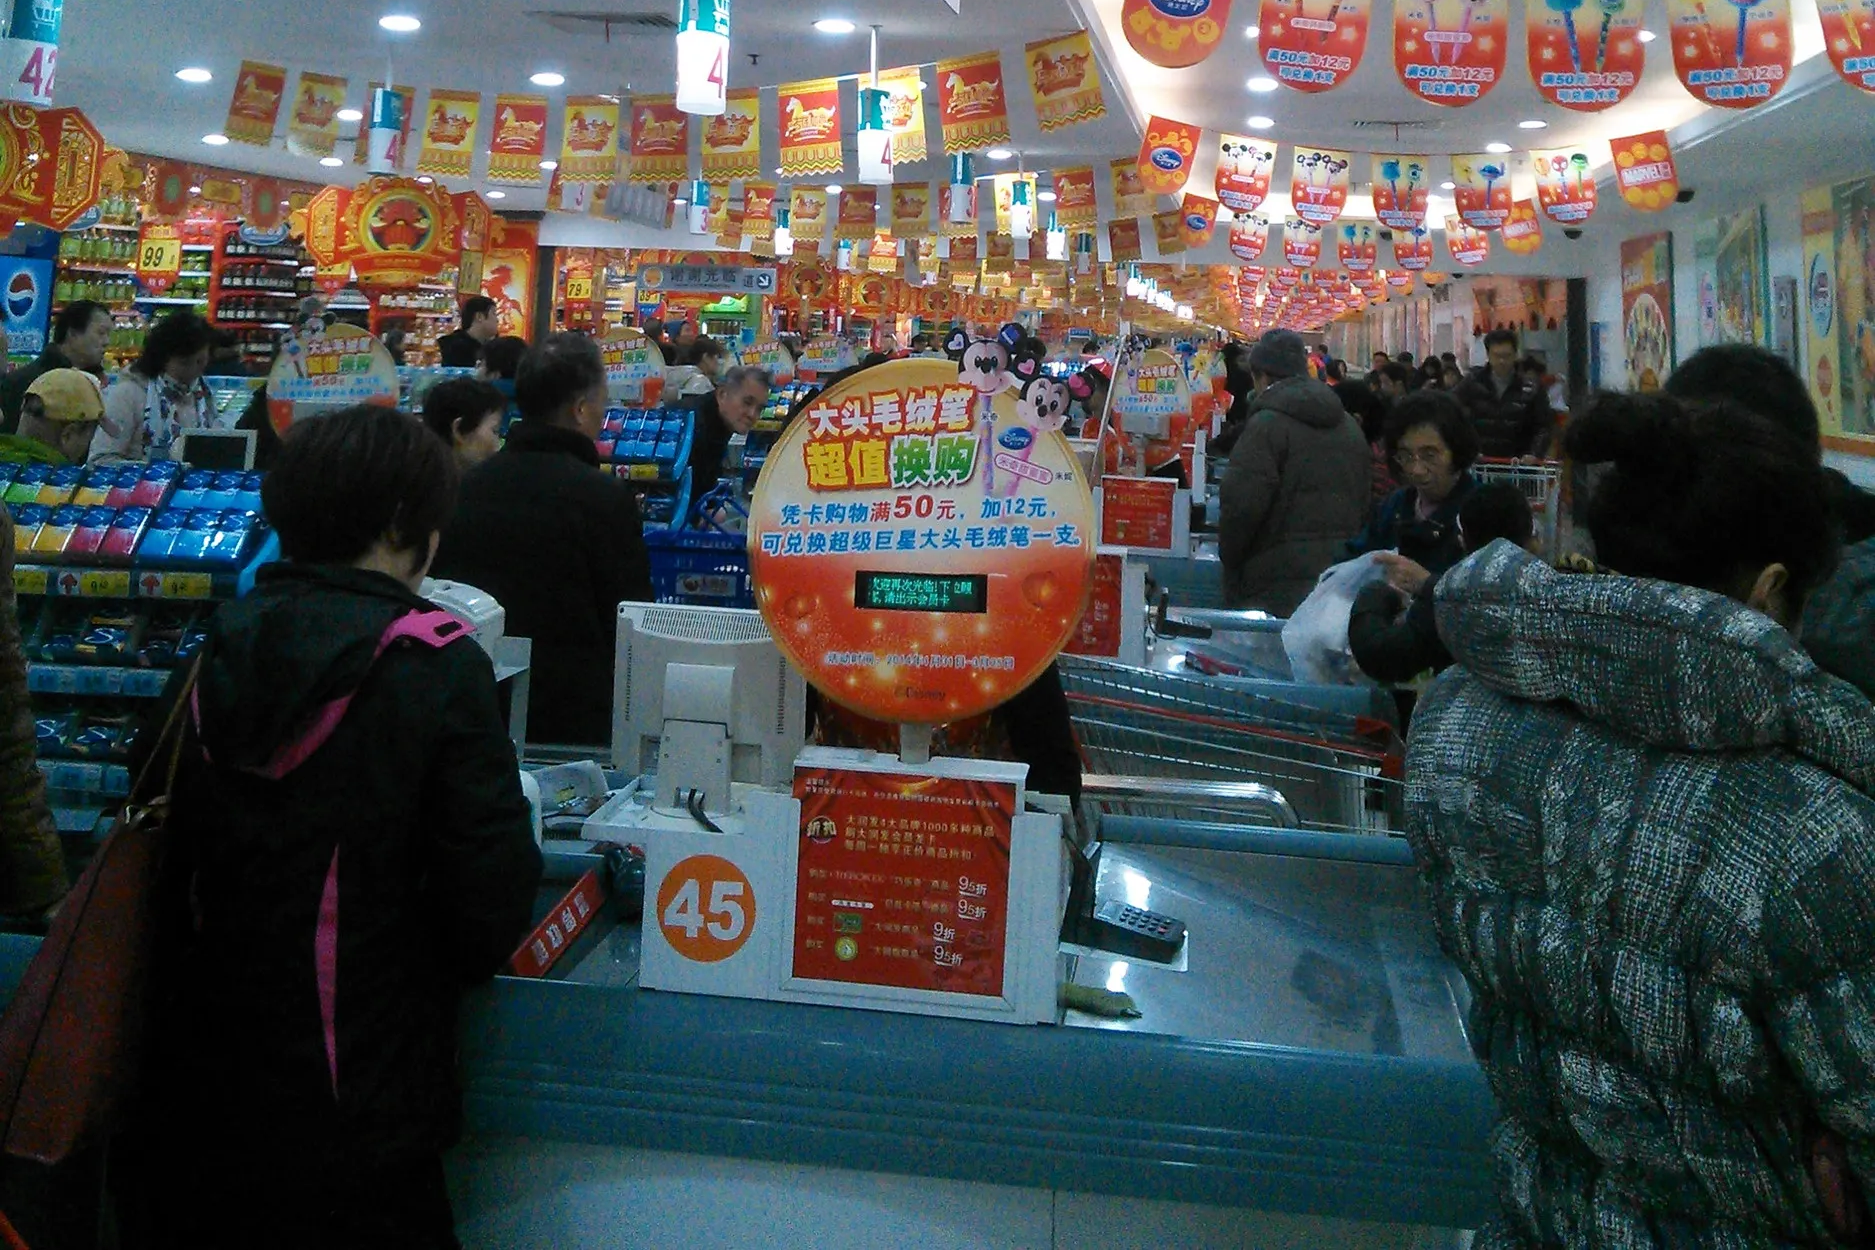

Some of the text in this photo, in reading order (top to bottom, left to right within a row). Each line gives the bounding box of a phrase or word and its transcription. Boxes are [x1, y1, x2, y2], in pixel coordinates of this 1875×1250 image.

[810, 386, 974, 437] 大头毛绒笔
[804, 434, 980, 488] 超值换购
[807, 820, 837, 837] 折扣
[664, 877, 745, 941] 45
